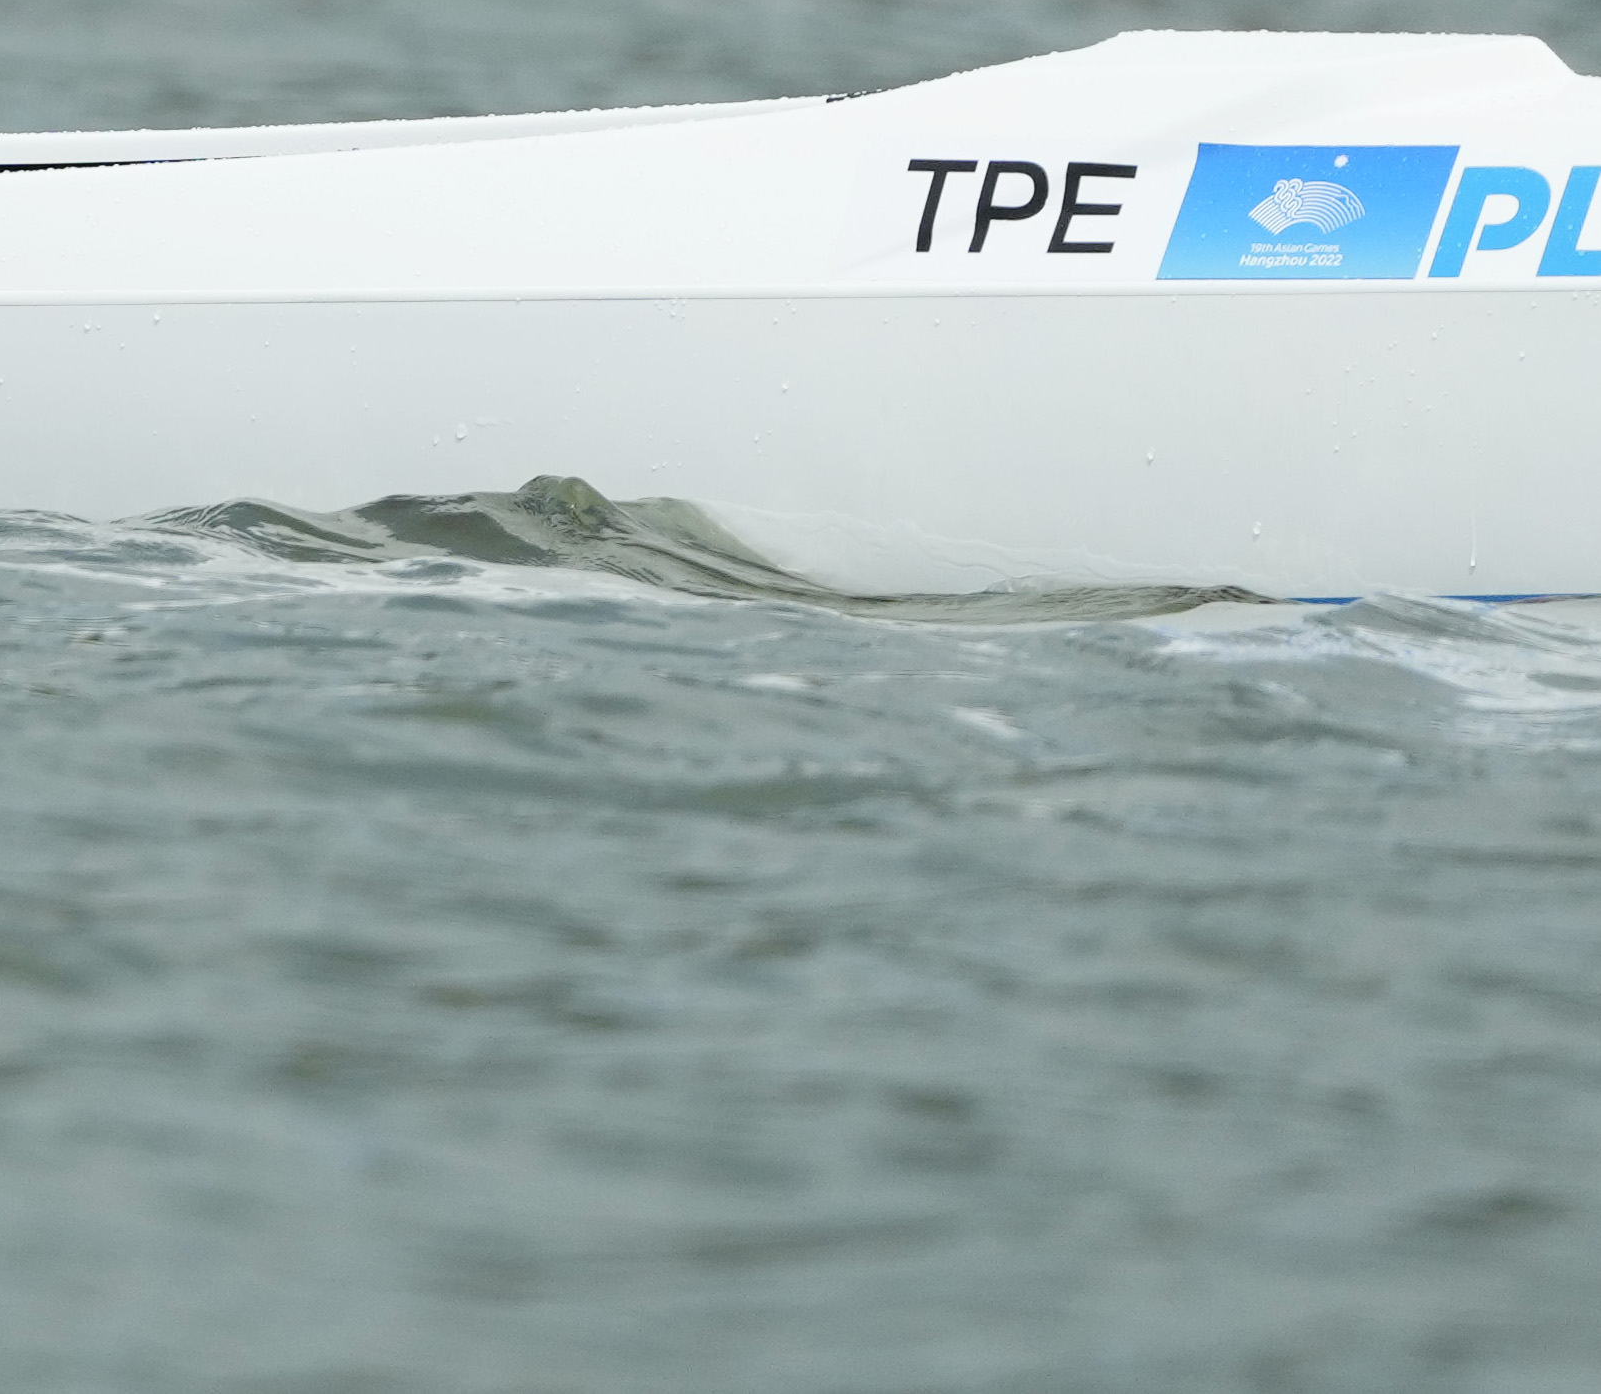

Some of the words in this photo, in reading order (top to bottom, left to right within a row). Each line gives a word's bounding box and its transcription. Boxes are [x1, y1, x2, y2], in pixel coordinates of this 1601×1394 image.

[907, 159, 1138, 253] TPE
[1250, 243, 1273, 253] 19th
[1273, 243, 1304, 253] Asian
[1304, 243, 1340, 253] Games
[1239, 254, 1308, 269] Hangzhou
[1309, 253, 1343, 266] 2022
